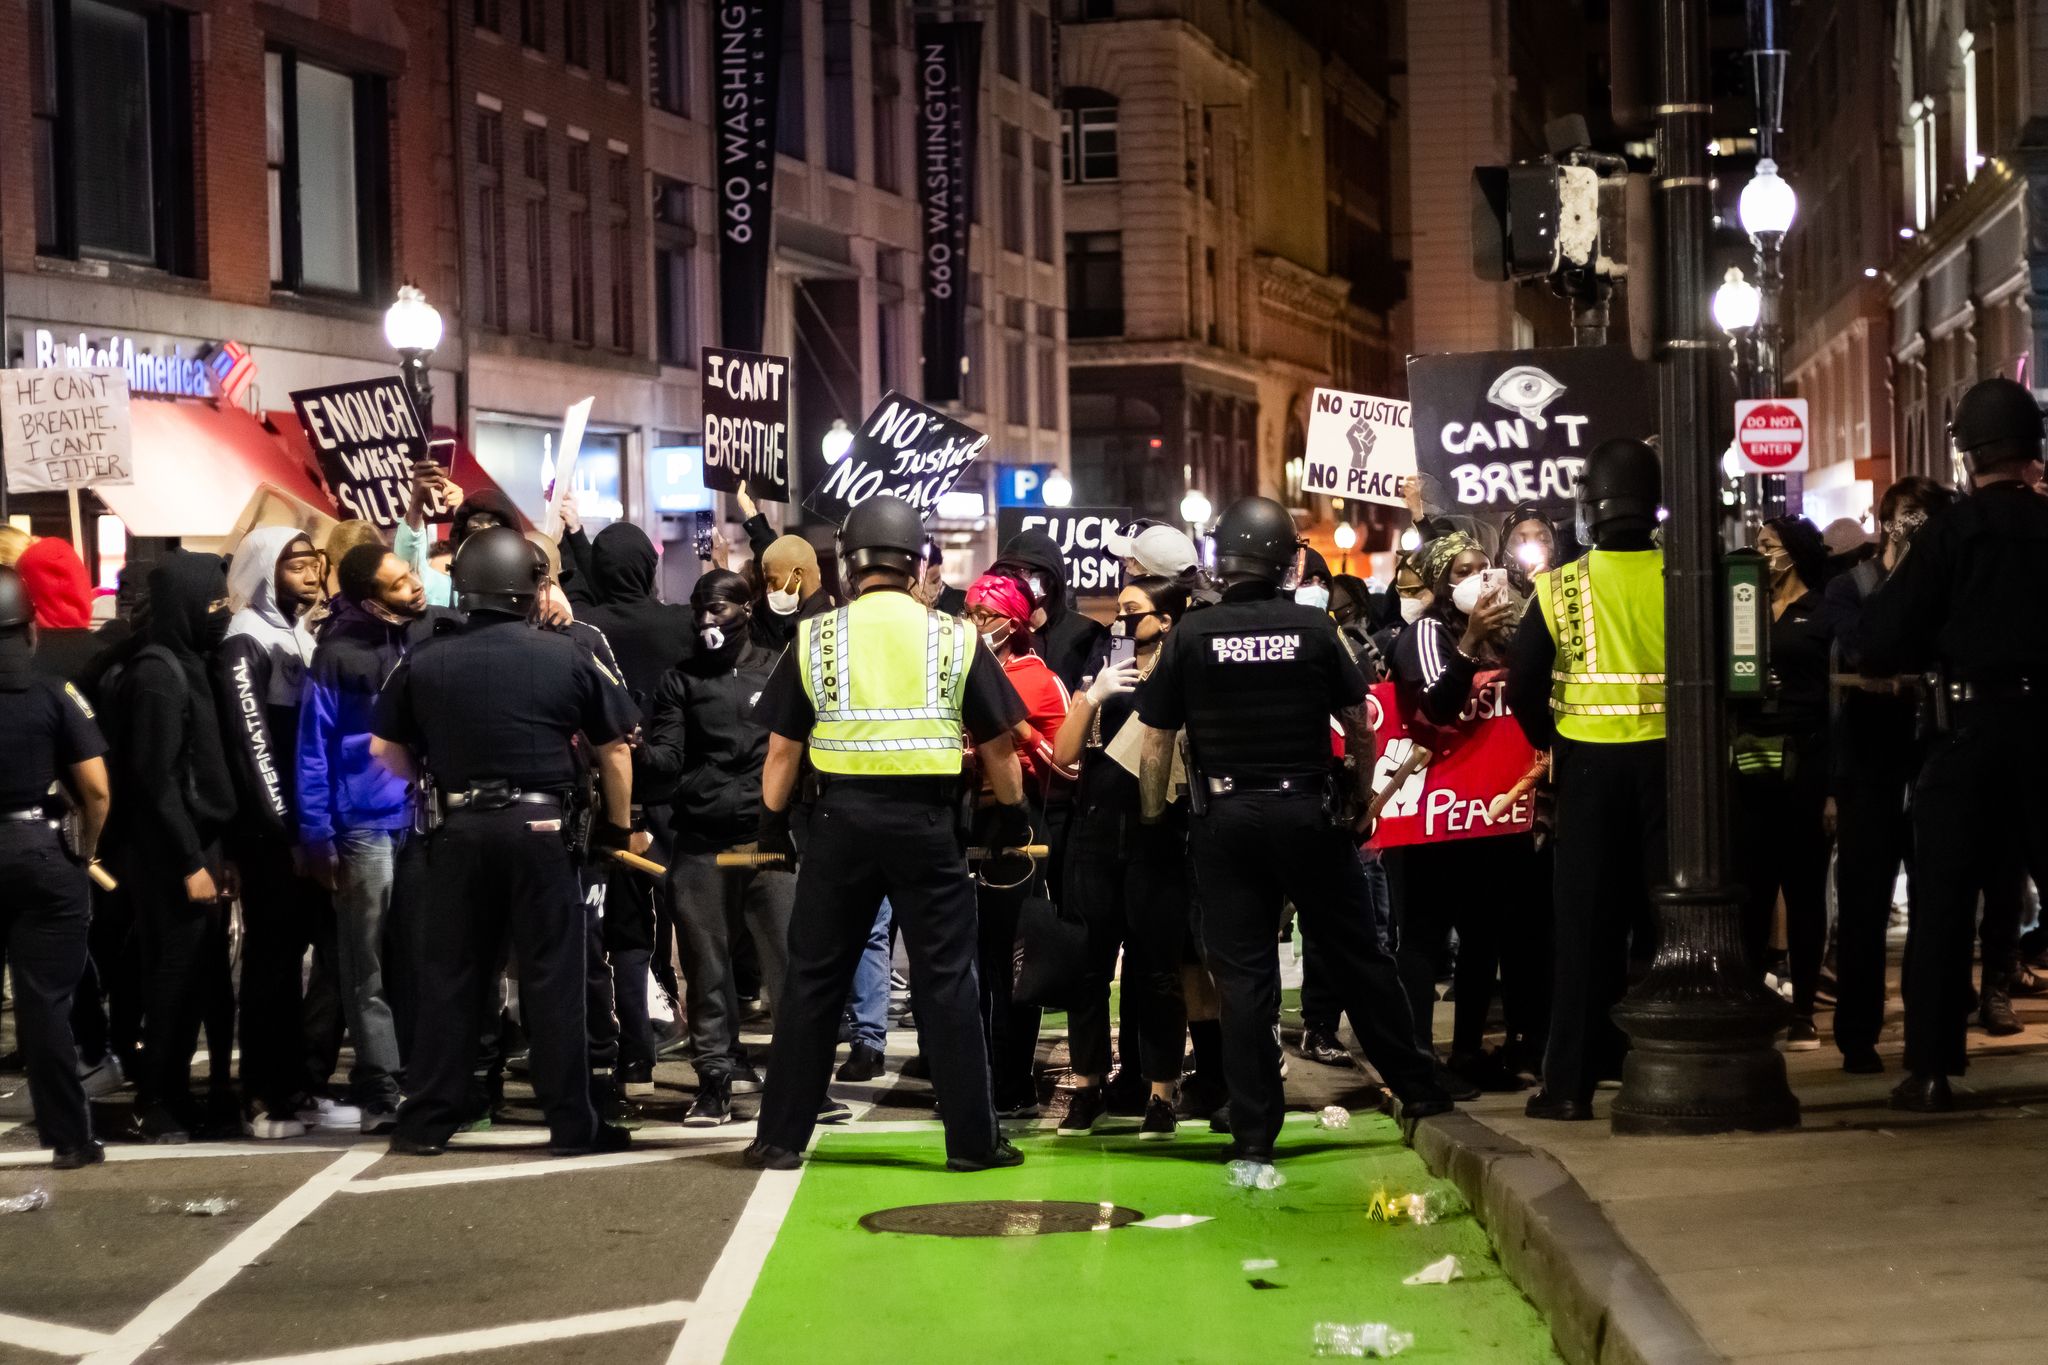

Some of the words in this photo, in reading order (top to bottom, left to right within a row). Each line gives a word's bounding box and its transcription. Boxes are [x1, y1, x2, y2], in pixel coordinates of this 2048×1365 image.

[720, 0, 750, 165] WASHING
[924, 44, 949, 234] WASHINGTON
[725, 176, 753, 244] 660
[929, 243, 951, 299] 660
[36, 329, 95, 368] Bnk
[123, 338, 206, 396] America
[708, 355, 724, 388] I
[17, 377, 47, 405] HE
[1316, 393, 1343, 414] NO
[1350, 399, 1414, 428] JUSTIC
[19, 405, 117, 439] BREATHE.
[302, 385, 419, 450] ENOUGH
[1746, 415, 1767, 428] DO
[1769, 415, 1797, 428] NOT
[23, 440, 41, 462] I
[705, 413, 785, 486] BREATHE
[1750, 443, 1793, 456] ENTER
[823, 457, 884, 507] NO
[1014, 469, 1039, 499] P
[1307, 462, 1338, 488] NO
[1347, 468, 1405, 498] PEACE
[1564, 574, 1584, 661] BOSTON
[821, 618, 838, 702] BOSTON
[1212, 635, 1300, 651] BOSTON
[1218, 647, 1295, 662] POLICE
[233, 656, 288, 816] INTERNATIONAL
